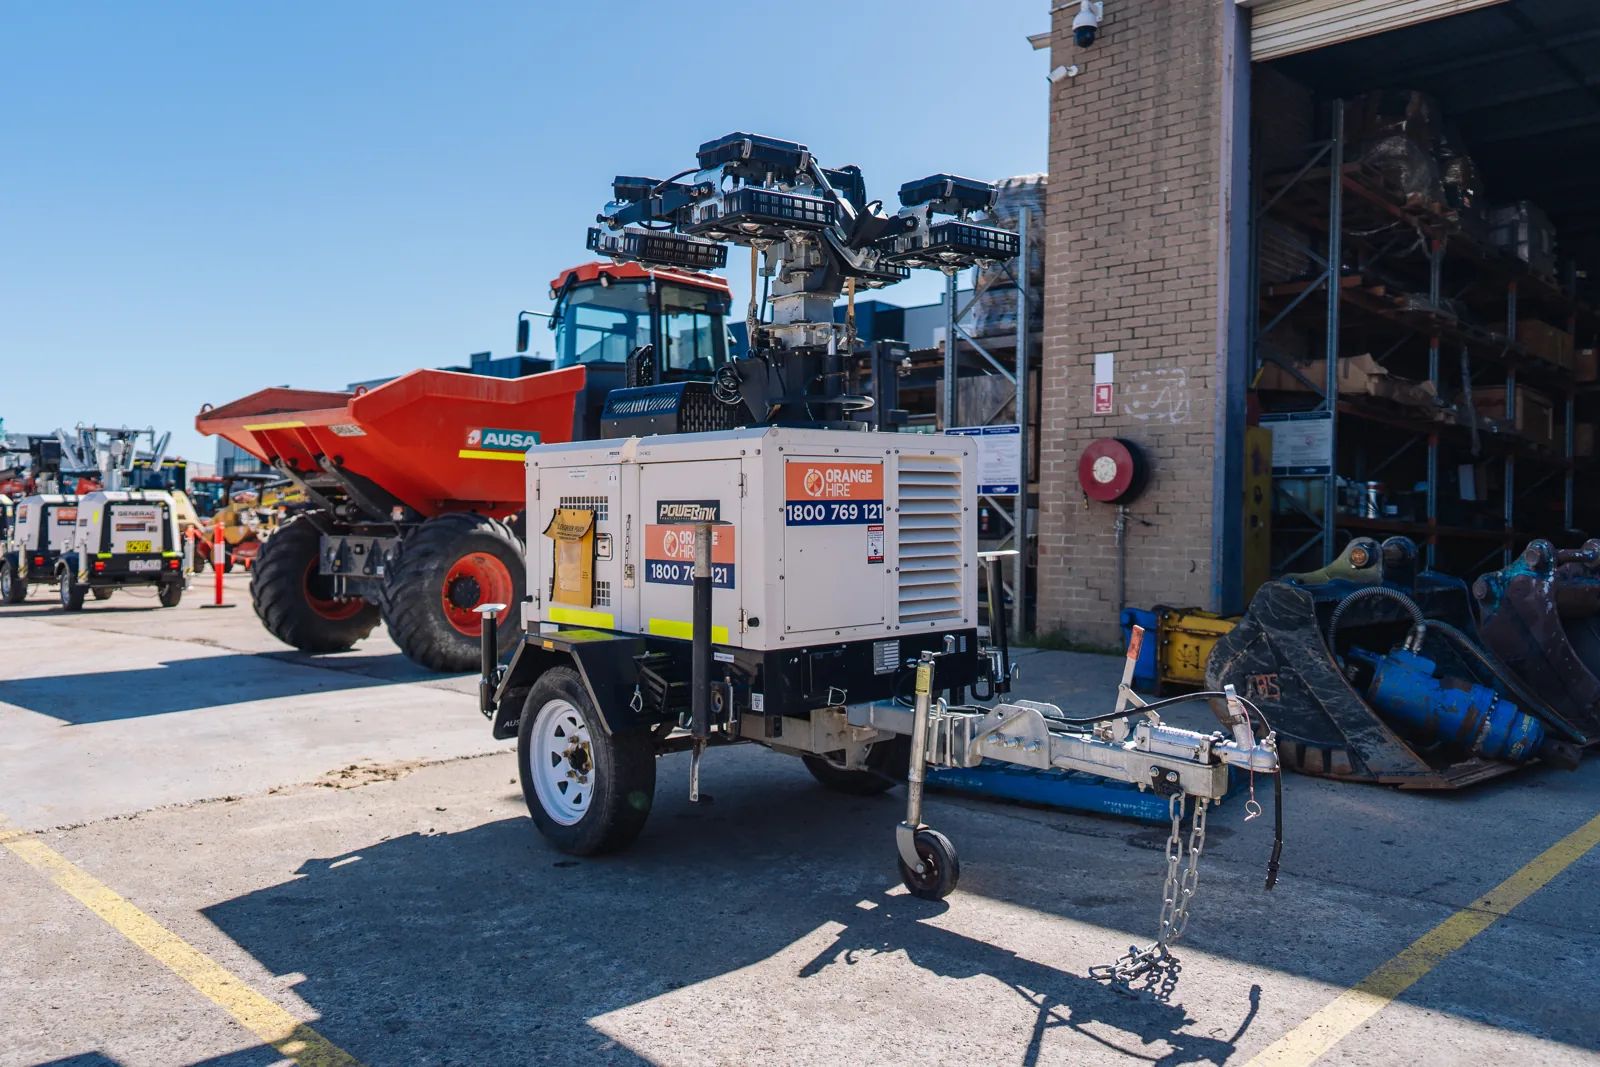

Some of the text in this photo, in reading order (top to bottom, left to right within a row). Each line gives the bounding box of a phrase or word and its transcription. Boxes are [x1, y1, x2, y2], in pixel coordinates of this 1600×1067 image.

[483, 432, 536, 447] AUSA
[825, 468, 873, 483] ORANGE
[825, 483, 851, 497] HIRE
[786, 503, 883, 521] 1800 769 121
[680, 545, 695, 558] HIR
[651, 563, 680, 580] 1800
[683, 565, 695, 581] 76
